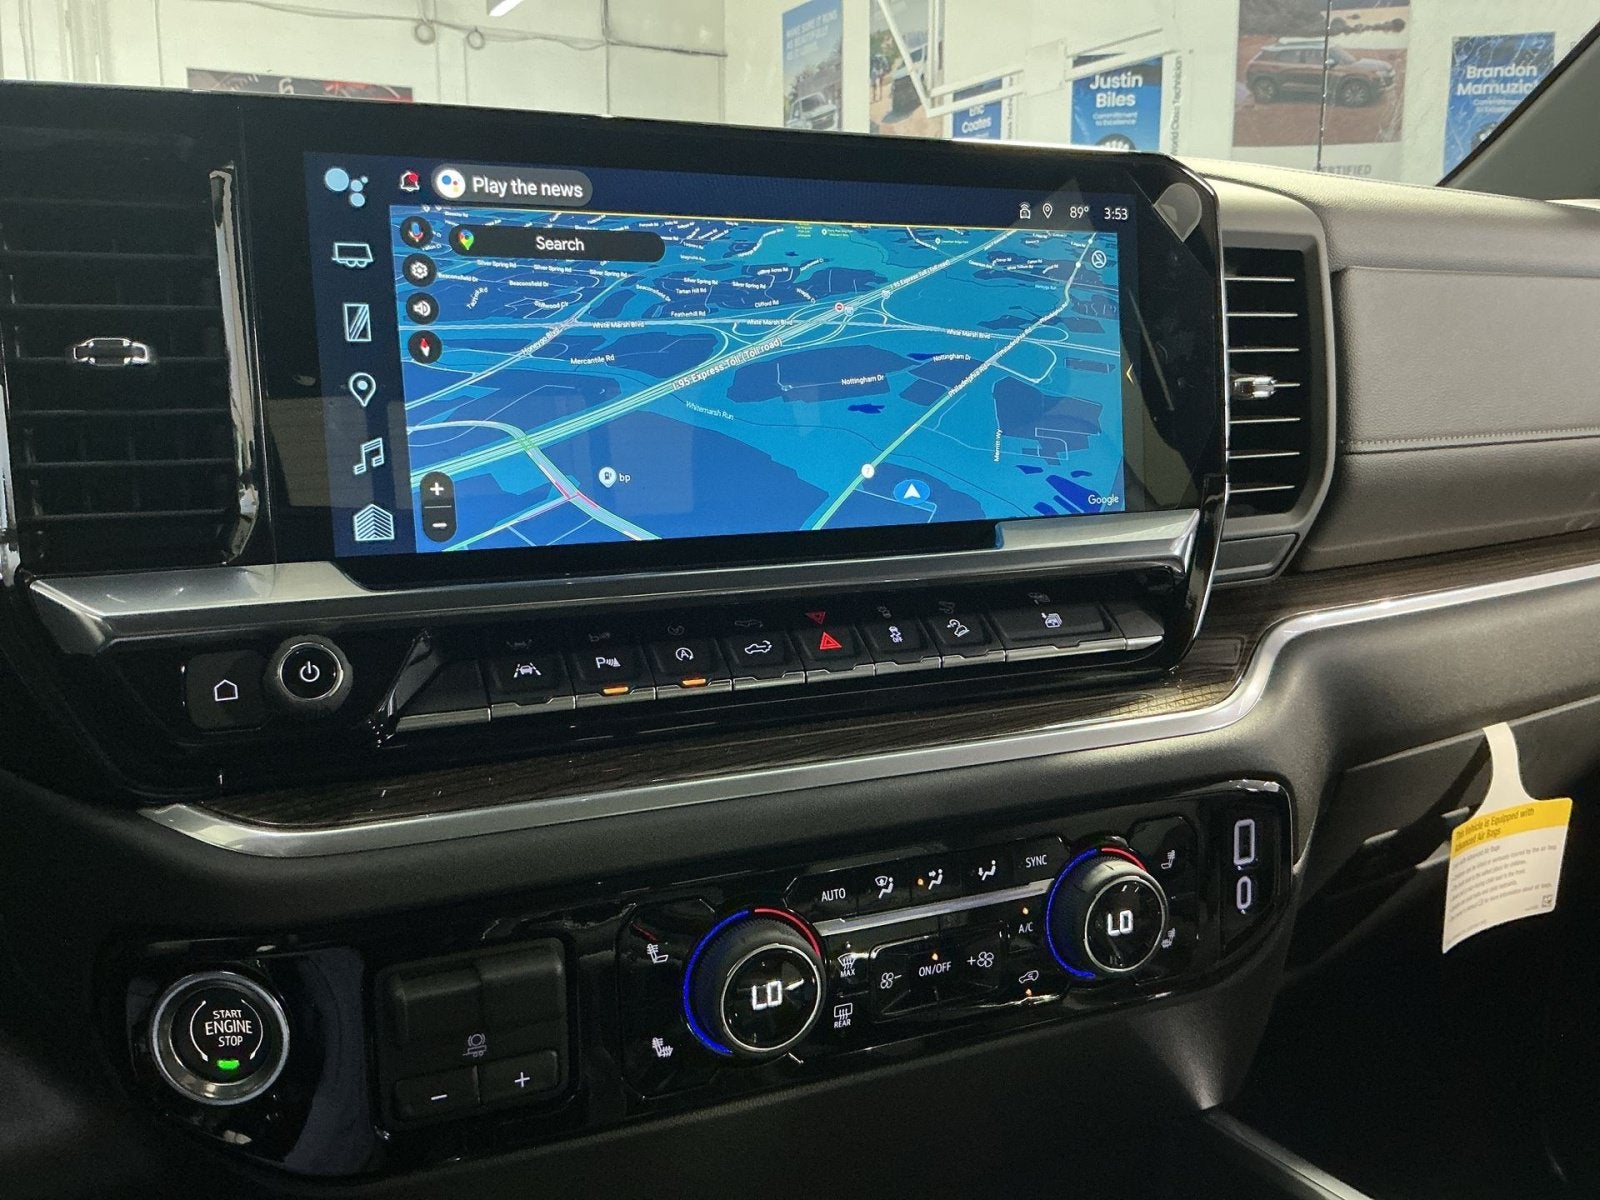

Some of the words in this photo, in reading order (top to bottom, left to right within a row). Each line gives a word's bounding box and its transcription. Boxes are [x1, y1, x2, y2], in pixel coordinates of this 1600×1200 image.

[1466, 63, 1538, 80] Brandon
[1090, 71, 1143, 90] Justin
[1172, 56, 1183, 104] Technician
[1095, 91, 1136, 108] Biles
[472, 176, 508, 197] Play
[510, 178, 538, 195] the
[541, 182, 584, 198] news
[1069, 205, 1090, 220] 89°
[1104, 206, 1128, 220] 3:53
[535, 236, 585, 252] Search
[477, 259, 491, 267] Silver
[492, 260, 509, 269] Spring
[548, 265, 564, 273] Spring
[439, 272, 470, 282] Beaconsfield
[589, 268, 603, 276] Silver
[508, 279, 542, 288] Beaconsfield
[698, 278, 711, 286] Spring
[745, 282, 761, 290] Spring
[630, 320, 645, 328] Blvd
[946, 328, 961, 336] White
[962, 330, 978, 338] Marsh
[978, 331, 991, 339] Blvd
[570, 355, 604, 365] Mercantile
[605, 354, 615, 362] Rd
[691, 365, 726, 383] Express
[725, 354, 741, 369] Toll
[741, 347, 760, 363] (Toll
[760, 337, 784, 354] road)
[933, 354, 964, 363] Nottingham
[965, 354, 972, 362] Dr
[841, 375, 876, 386] Nottingham
[877, 374, 885, 382] Dr
[948, 369, 980, 398] Philadelphia
[978, 361, 990, 373] Rd
[686, 400, 721, 417] Whitemarsh
[722, 410, 735, 421] Run
[619, 472, 631, 483] bp
[1088, 493, 1120, 506] Google
[1490, 810, 1520, 828] Equipped
[1520, 807, 1535, 817] with
[1025, 854, 1048, 868] SYNC
[821, 888, 846, 903] AUTO
[1018, 922, 1034, 934] A/C
[1107, 909, 1134, 937] LO
[840, 968, 856, 978] MAX
[918, 962, 952, 977] ON/OFF
[751, 980, 783, 1011] LO
[212, 1009, 242, 1019] START
[205, 1020, 253, 1036] ENGINE
[834, 1018, 851, 1029] REAR
[218, 1035, 244, 1047] STOP
